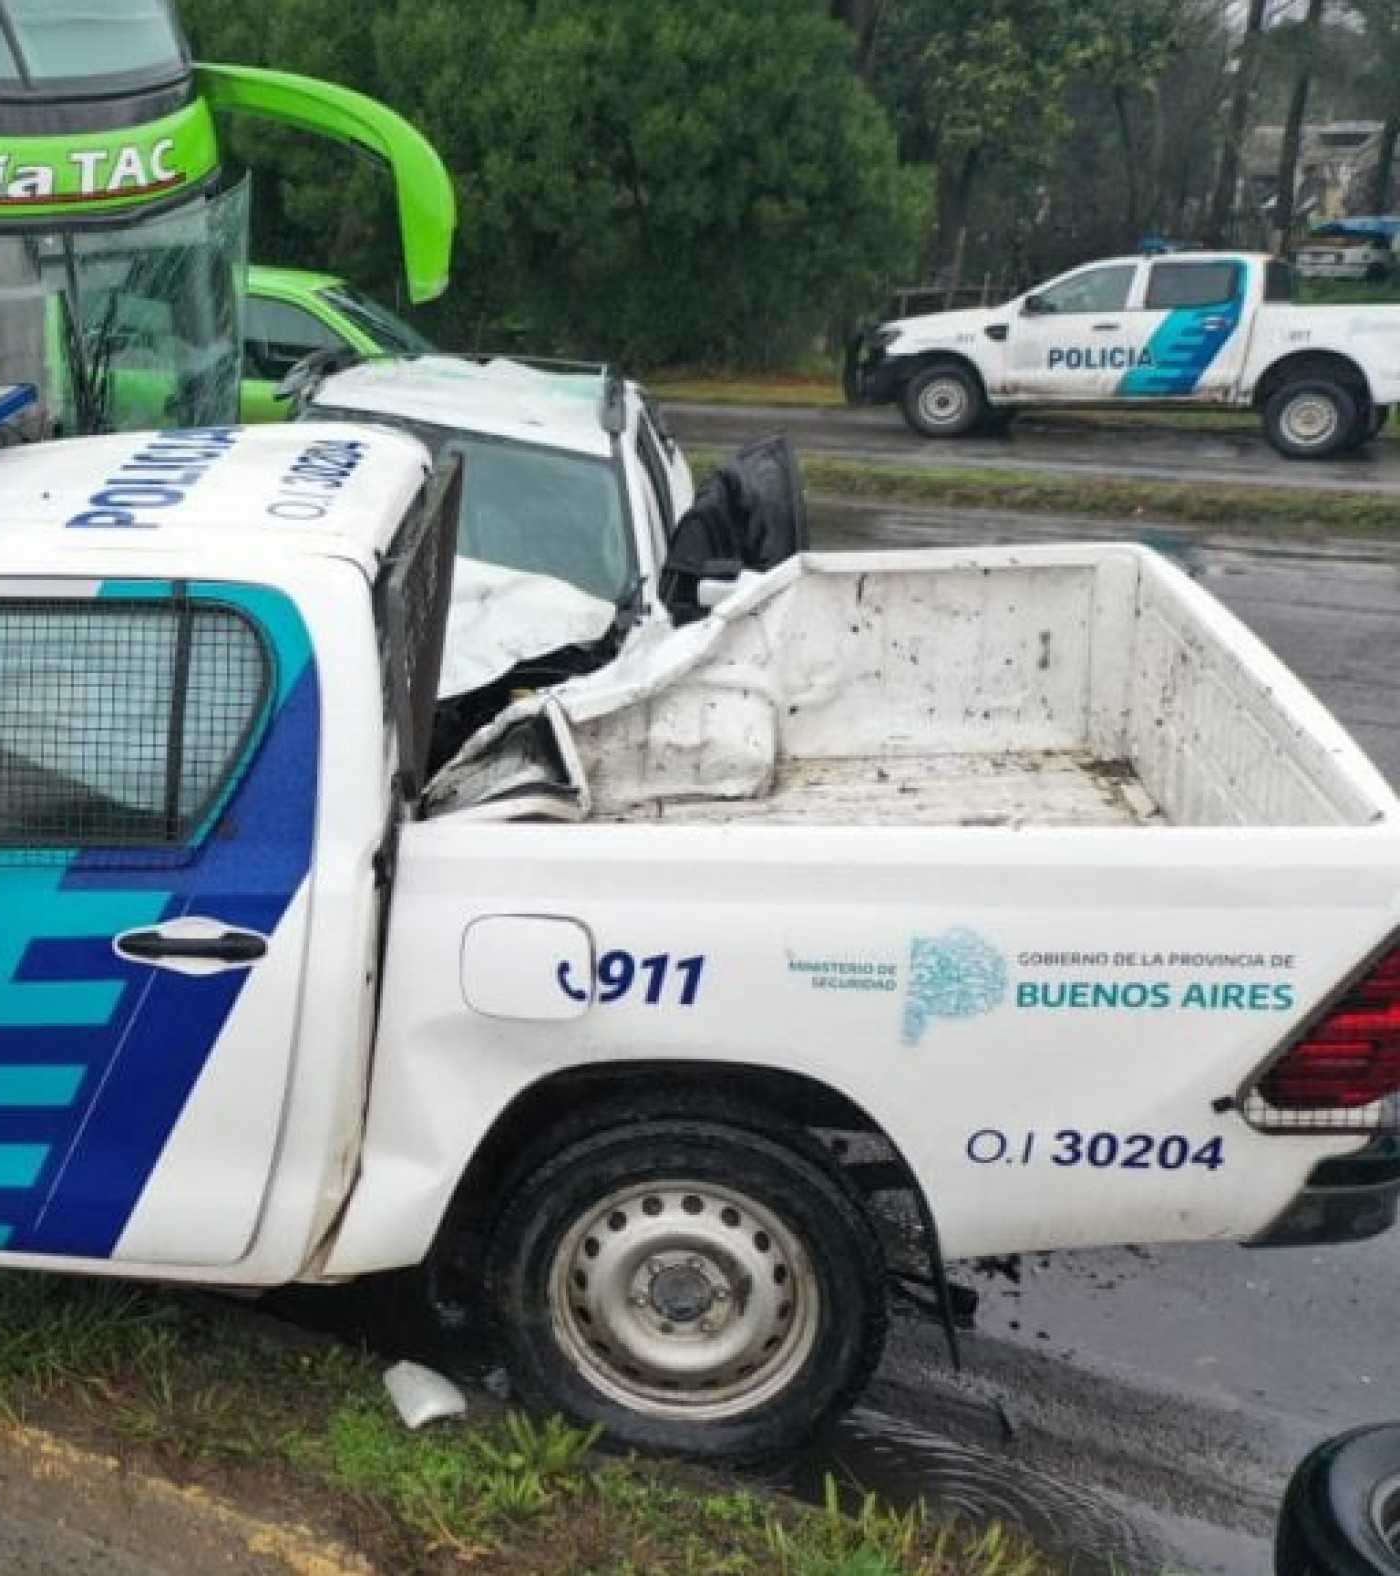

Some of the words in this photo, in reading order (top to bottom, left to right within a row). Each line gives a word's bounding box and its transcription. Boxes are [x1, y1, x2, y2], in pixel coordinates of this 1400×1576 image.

[68, 138, 179, 197] TAC
[1047, 345, 1156, 371] POLICIA
[64, 426, 243, 528] POLICIA
[598, 948, 706, 1005] 911
[1016, 951, 1109, 967] GOBIERNO
[1112, 952, 1139, 967] DE
[1141, 952, 1164, 967] LA
[1167, 952, 1265, 968] PROVINCIA
[1270, 954, 1298, 969] DE
[1016, 981, 1171, 1008] BUENOS
[1180, 983, 1294, 1011] AIRES
[1050, 1129, 1225, 1171] 30204
